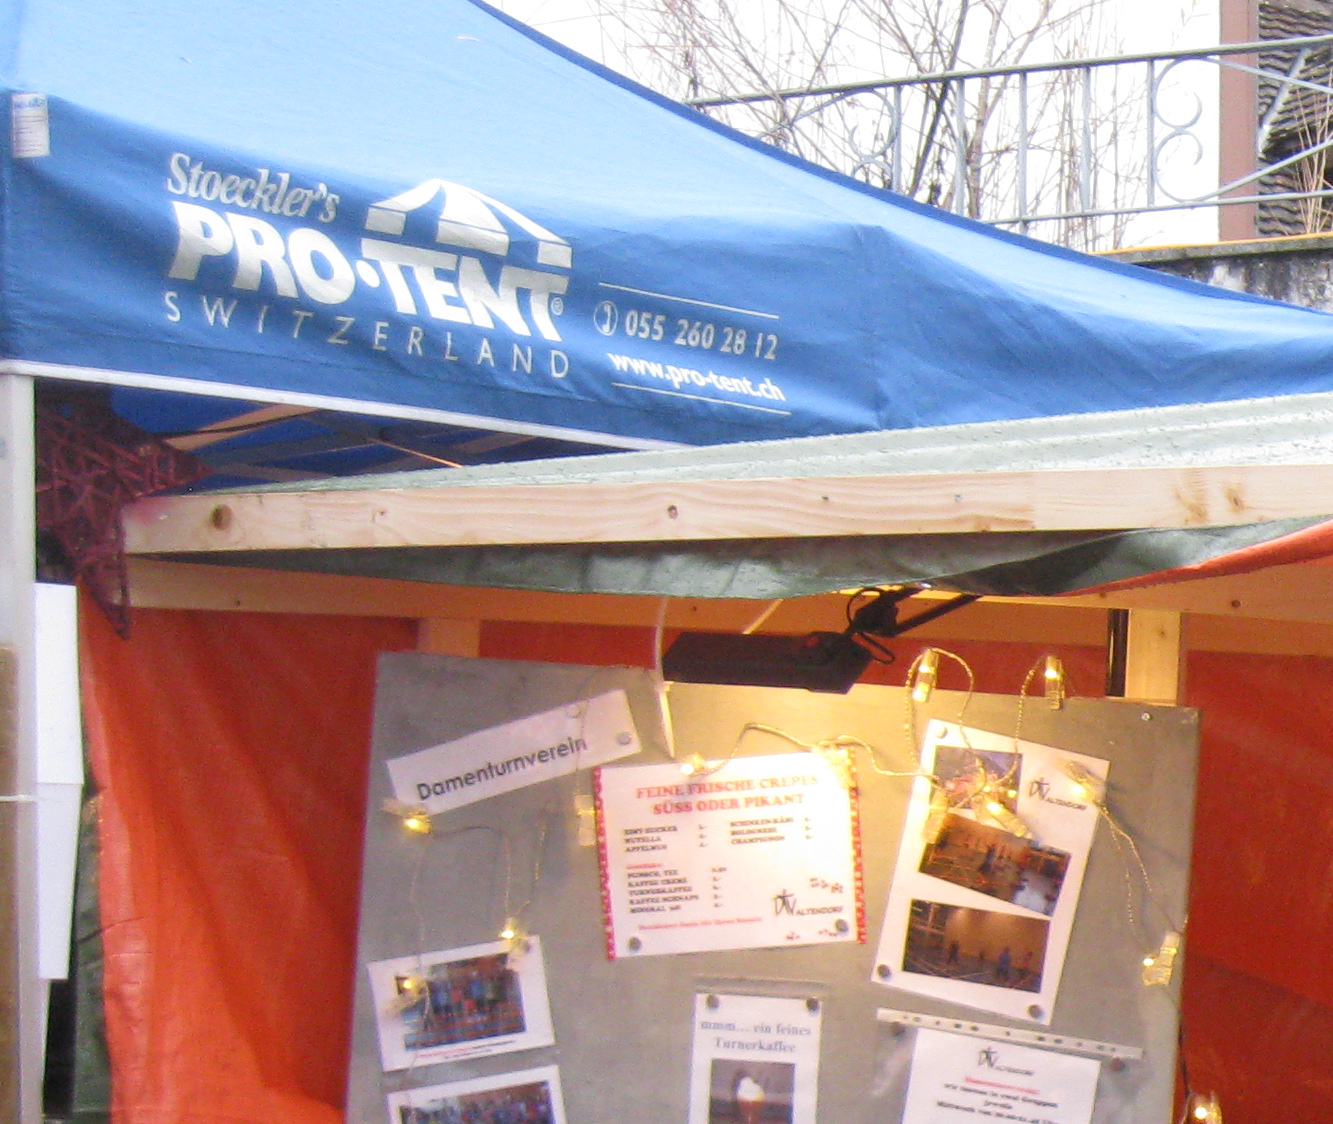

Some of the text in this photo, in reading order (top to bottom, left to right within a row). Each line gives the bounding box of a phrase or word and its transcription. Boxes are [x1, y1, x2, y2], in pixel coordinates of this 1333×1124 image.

[167, 152, 340, 223] Stoeckler's
[163, 291, 570, 379] SWITZERLAND
[625, 309, 778, 361] 055 260 28 12
[607, 353, 787, 401] www.pro-tent.ch
[417, 736, 587, 800] Damenturnverein
[636, 783, 687, 799] FEINE
[688, 778, 755, 795] FRISCHE
[696, 797, 740, 812] ODER
[744, 793, 805, 809] PIKANT
